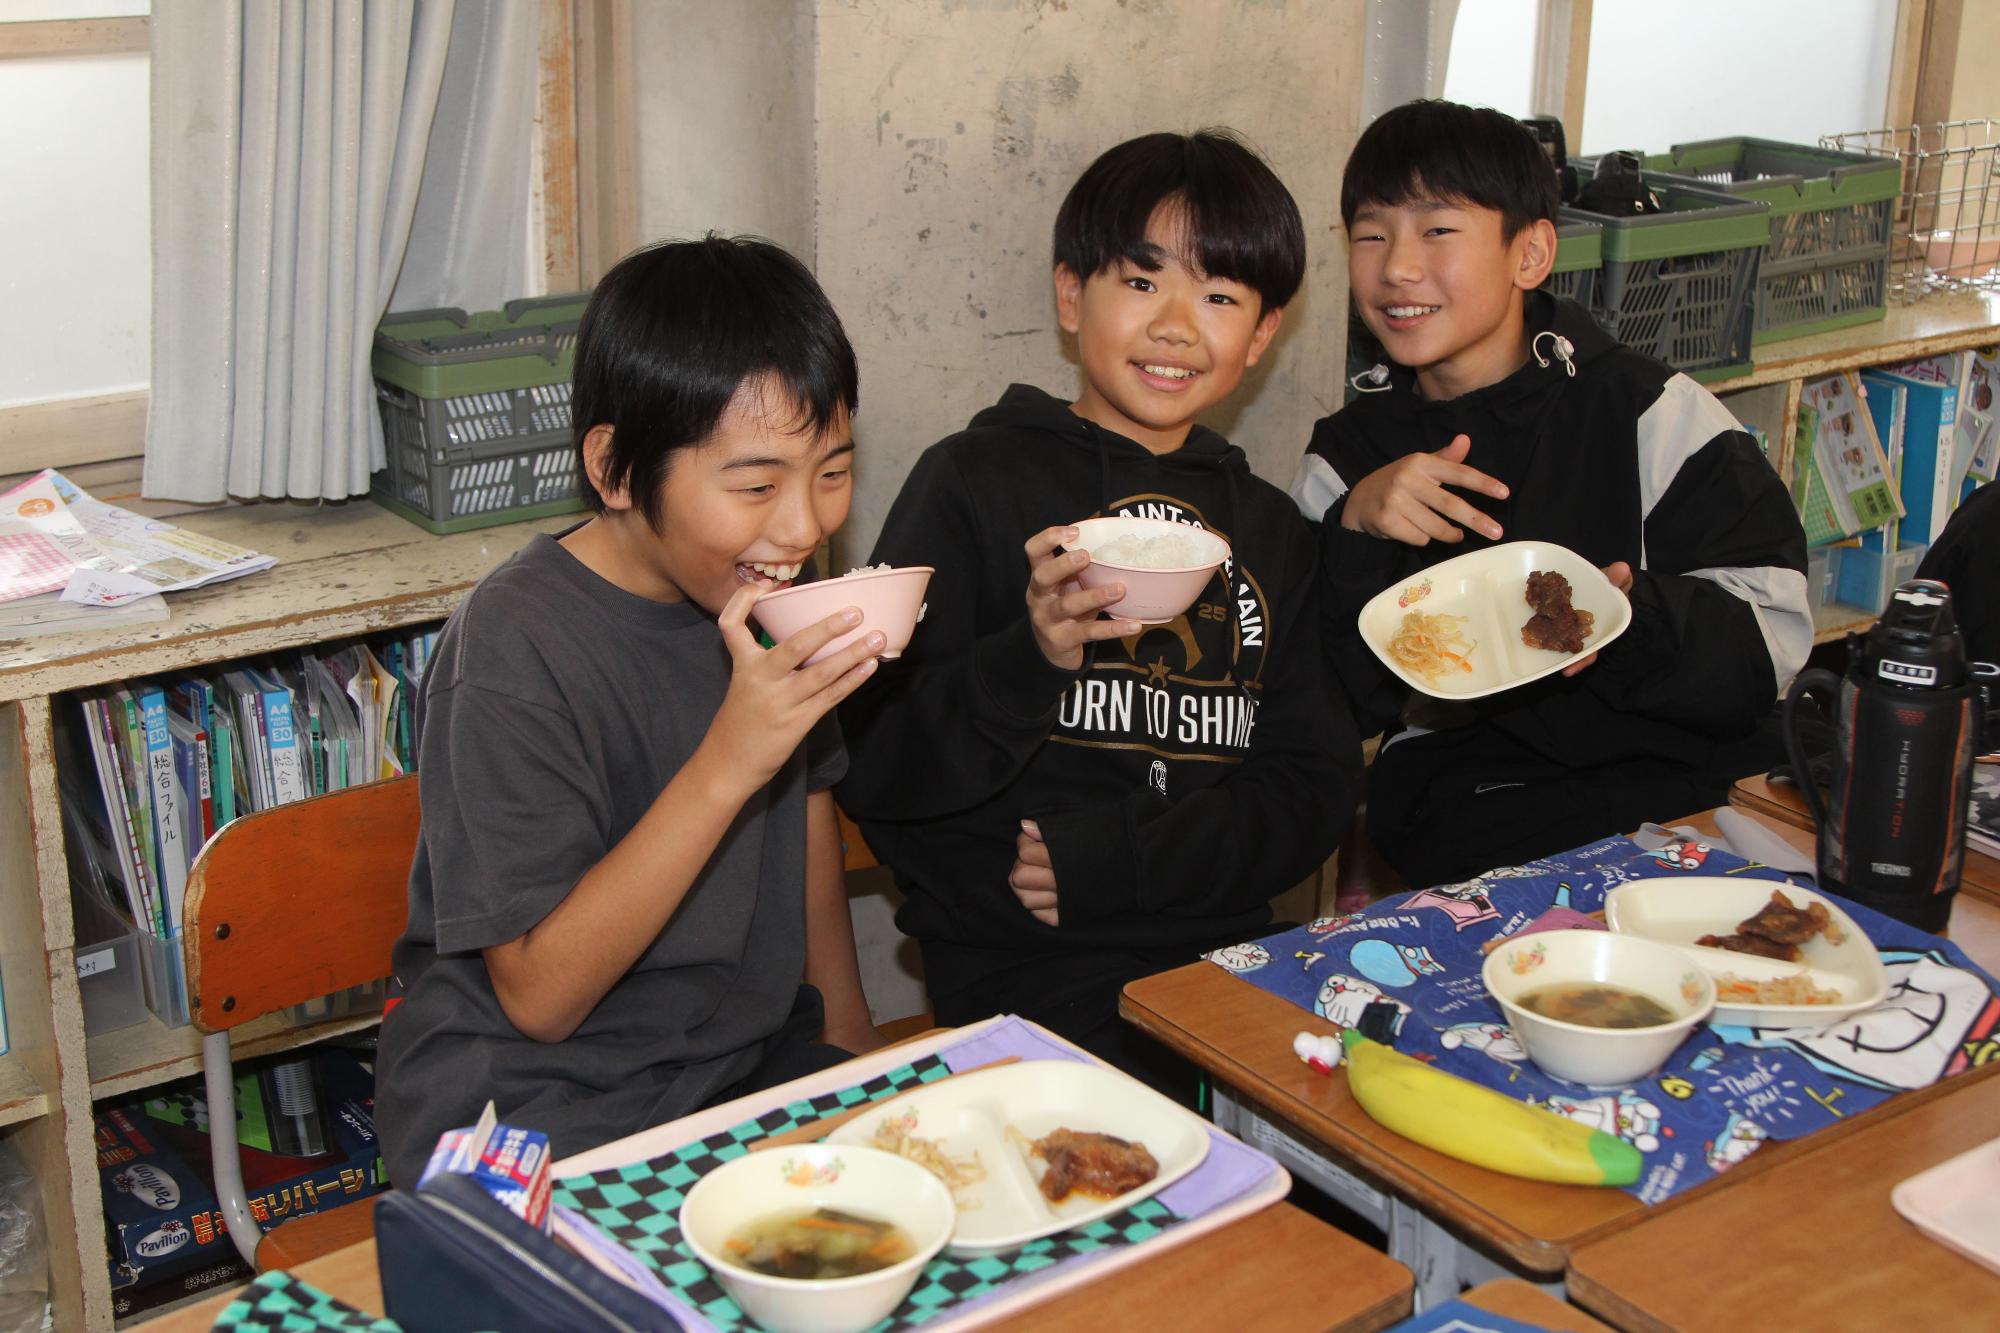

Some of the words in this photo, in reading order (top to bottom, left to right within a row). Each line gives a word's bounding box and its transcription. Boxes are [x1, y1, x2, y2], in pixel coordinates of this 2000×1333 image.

[1198, 602, 1228, 623] 25
[146, 704, 164, 718] A4
[270, 704, 289, 715] A4
[1140, 684, 1170, 739] TO
[150, 730, 166, 743] 30
[274, 729, 291, 740] 30
[154, 754, 177, 844] 総合ファイル
[1870, 862, 1912, 877] THERMOS
[1717, 1063, 1776, 1097] Thank
[132, 1165, 174, 1208] Pavilion
[140, 1230, 188, 1254] Pavilion
